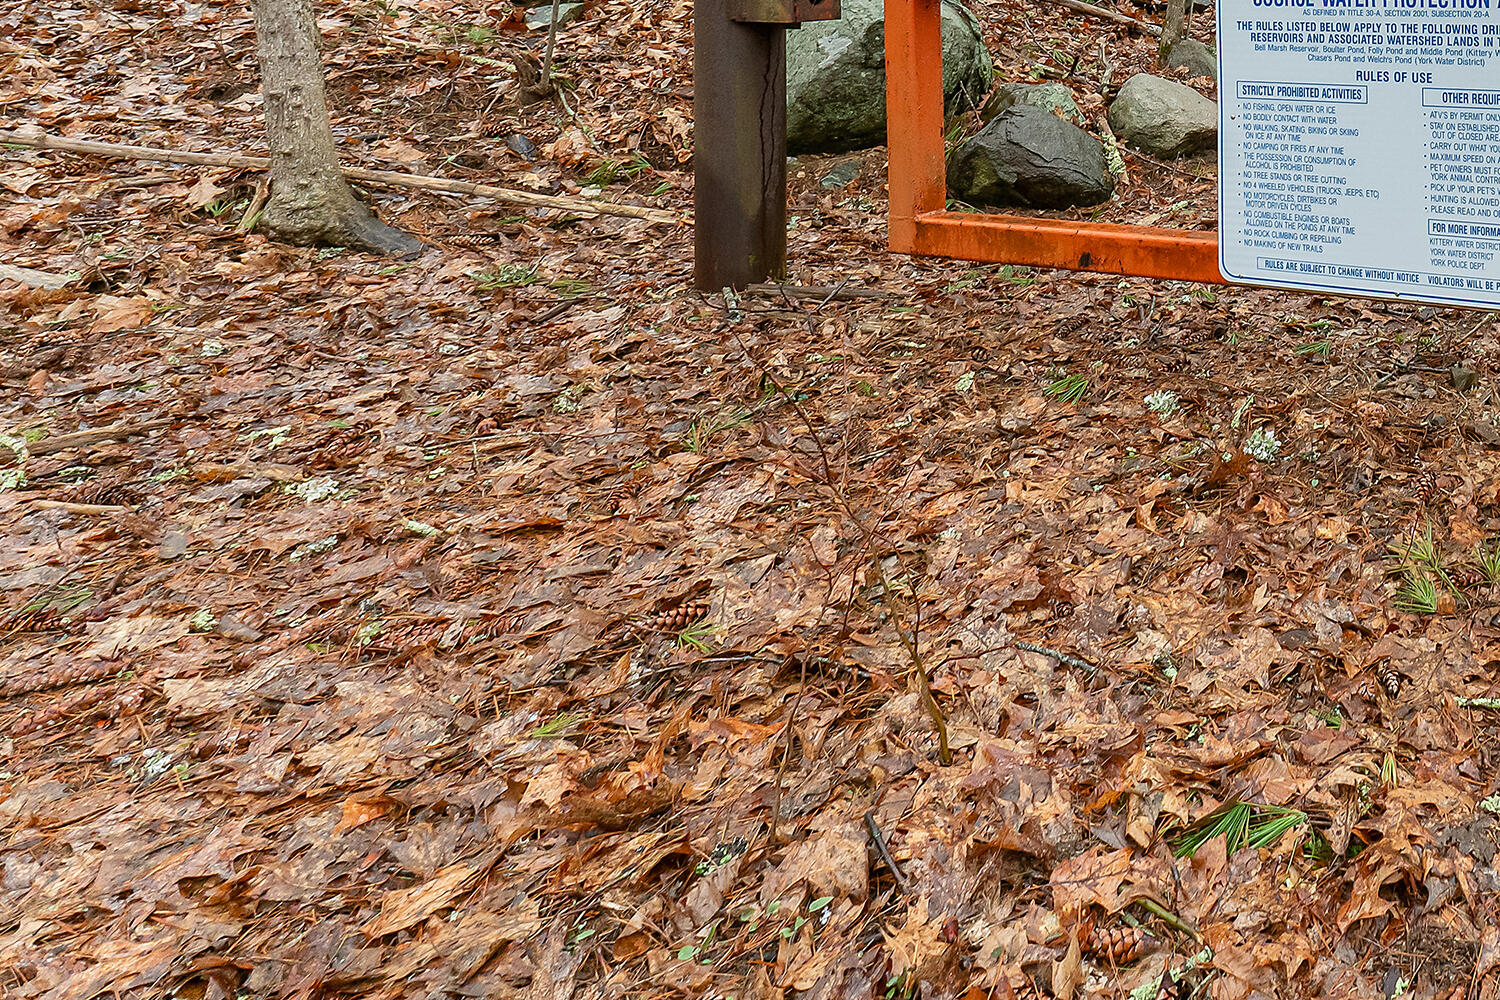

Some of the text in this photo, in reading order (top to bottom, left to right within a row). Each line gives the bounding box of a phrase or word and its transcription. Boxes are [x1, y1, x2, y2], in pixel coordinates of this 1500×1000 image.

[1237, 21, 1252, 30] THE
[1256, 21, 1283, 31] RULES
[1287, 22, 1316, 31] LISTED
[1320, 22, 1350, 32] BELOW
[1354, 23, 1381, 32] APPLY
[1386, 23, 1397, 33] TO
[1401, 23, 1418, 33] THE
[1422, 24, 1477, 34] FOLLOWING
[1251, 33, 1303, 43] RESERVOIRS
[1307, 34, 1324, 43] AND
[1328, 34, 1383, 45] ASSOCIATED
[1388, 35, 1443, 46] WATERSHED
[1448, 36, 1479, 46] LANDS
[1484, 37, 1493, 47] IN
[1268, 44, 1287, 52] Marsh
[1323, 45, 1345, 53] Boulter
[1368, 46, 1383, 55] Folly
[1406, 47, 1417, 55] and
[1421, 47, 1442, 55] Middle
[1445, 48, 1463, 56] Pond
[1466, 48, 1491, 58] (Kittery
[1308, 54, 1332, 62] Chase's
[1353, 55, 1365, 63] and
[1368, 55, 1392, 63] Welch's
[1395, 56, 1412, 64] Pond
[1415, 56, 1432, 66] (York
[1435, 57, 1455, 65] Water
[1457, 57, 1485, 66] District)
[1356, 71, 1432, 83] RULES OF USE
[1242, 85, 1361, 99] STRICTLY PROHIBITED ACTIVITIES
[1442, 92, 1469, 104] OTHER
[1446, 123, 1455, 131] ON
[1458, 124, 1499, 133] ESTABLISHED
[1432, 131, 1444, 139] OUT
[1447, 132, 1456, 140] OF
[1458, 133, 1483, 141] CLOSED
[1253, 143, 1278, 151] CAMPING
[1317, 146, 1329, 154] ANY
[1430, 142, 1451, 150] CARRY
[1469, 144, 1487, 152] WHAT
[1254, 172, 1268, 180] TREE
[1270, 173, 1291, 181] STANDS
[1304, 175, 1318, 183] TREE
[1321, 176, 1346, 184] CUTTING
[1431, 184, 1444, 192] PICK
[1447, 185, 1455, 193] UP
[1457, 186, 1475, 194] YOUR
[1477, 187, 1495, 195] PET'S
[1431, 195, 1458, 204] HUNTING
[1468, 197, 1499, 206] ALLOWED
[1431, 206, 1455, 215] PLEASE
[1457, 208, 1475, 216] READ
[1477, 209, 1491, 217] AND
[1433, 223, 1446, 233] FOR
[1448, 224, 1467, 235] MORE
[1244, 239, 1323, 253] NO MAKING OF NEW TRAILS
[1430, 238, 1453, 247] KITTERY
[1456, 240, 1474, 249] WATER
[1476, 242, 1500, 251] DISTRICT
[1430, 259, 1446, 267] YORK
[1448, 260, 1467, 269] POLICE
[1265, 260, 1283, 270] RULES
[1286, 262, 1297, 272] ARE
[1300, 264, 1325, 274] SUBJECT
[1328, 266, 1336, 275] TO
[1338, 267, 1362, 278] CHANGE
[1365, 270, 1394, 281] WITHOUT
[1396, 273, 1419, 283] NOTICE
[1428, 276, 1464, 287] VIOLATORS
[1467, 279, 1482, 289] WILL
[1485, 281, 1494, 290] BE
